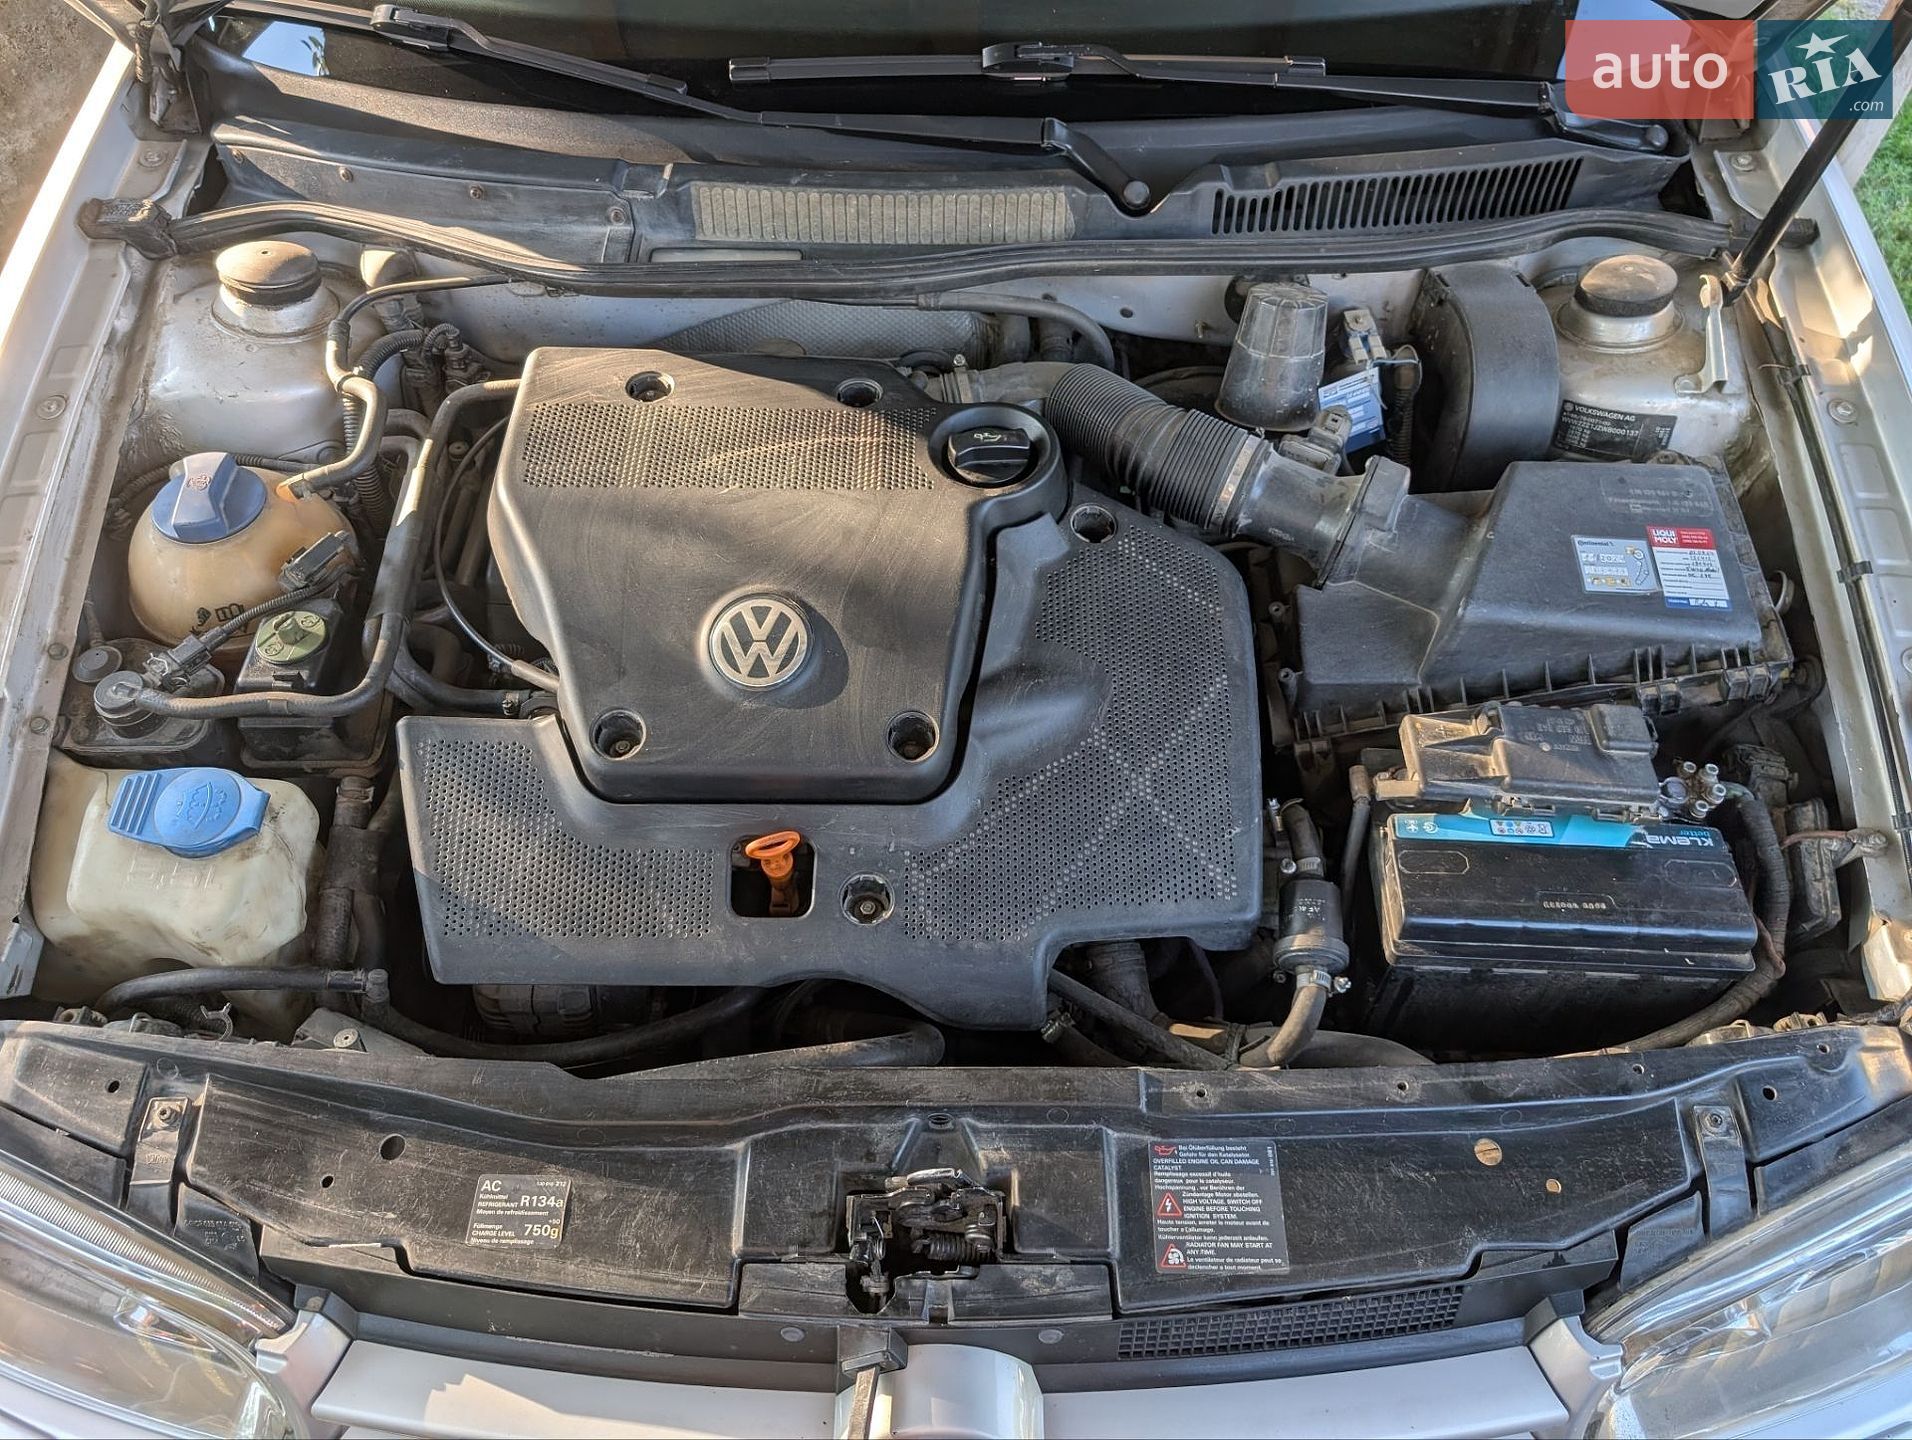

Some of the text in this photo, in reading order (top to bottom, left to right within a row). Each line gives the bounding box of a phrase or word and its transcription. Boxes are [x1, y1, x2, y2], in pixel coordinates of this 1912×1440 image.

[1575, 405, 1624, 420] VOLKSWAGEN
[712, 599, 807, 687] VW
[481, 1180, 501, 1191] AC
[521, 1196, 563, 1207] R134a
[525, 1224, 559, 1239] 750g
